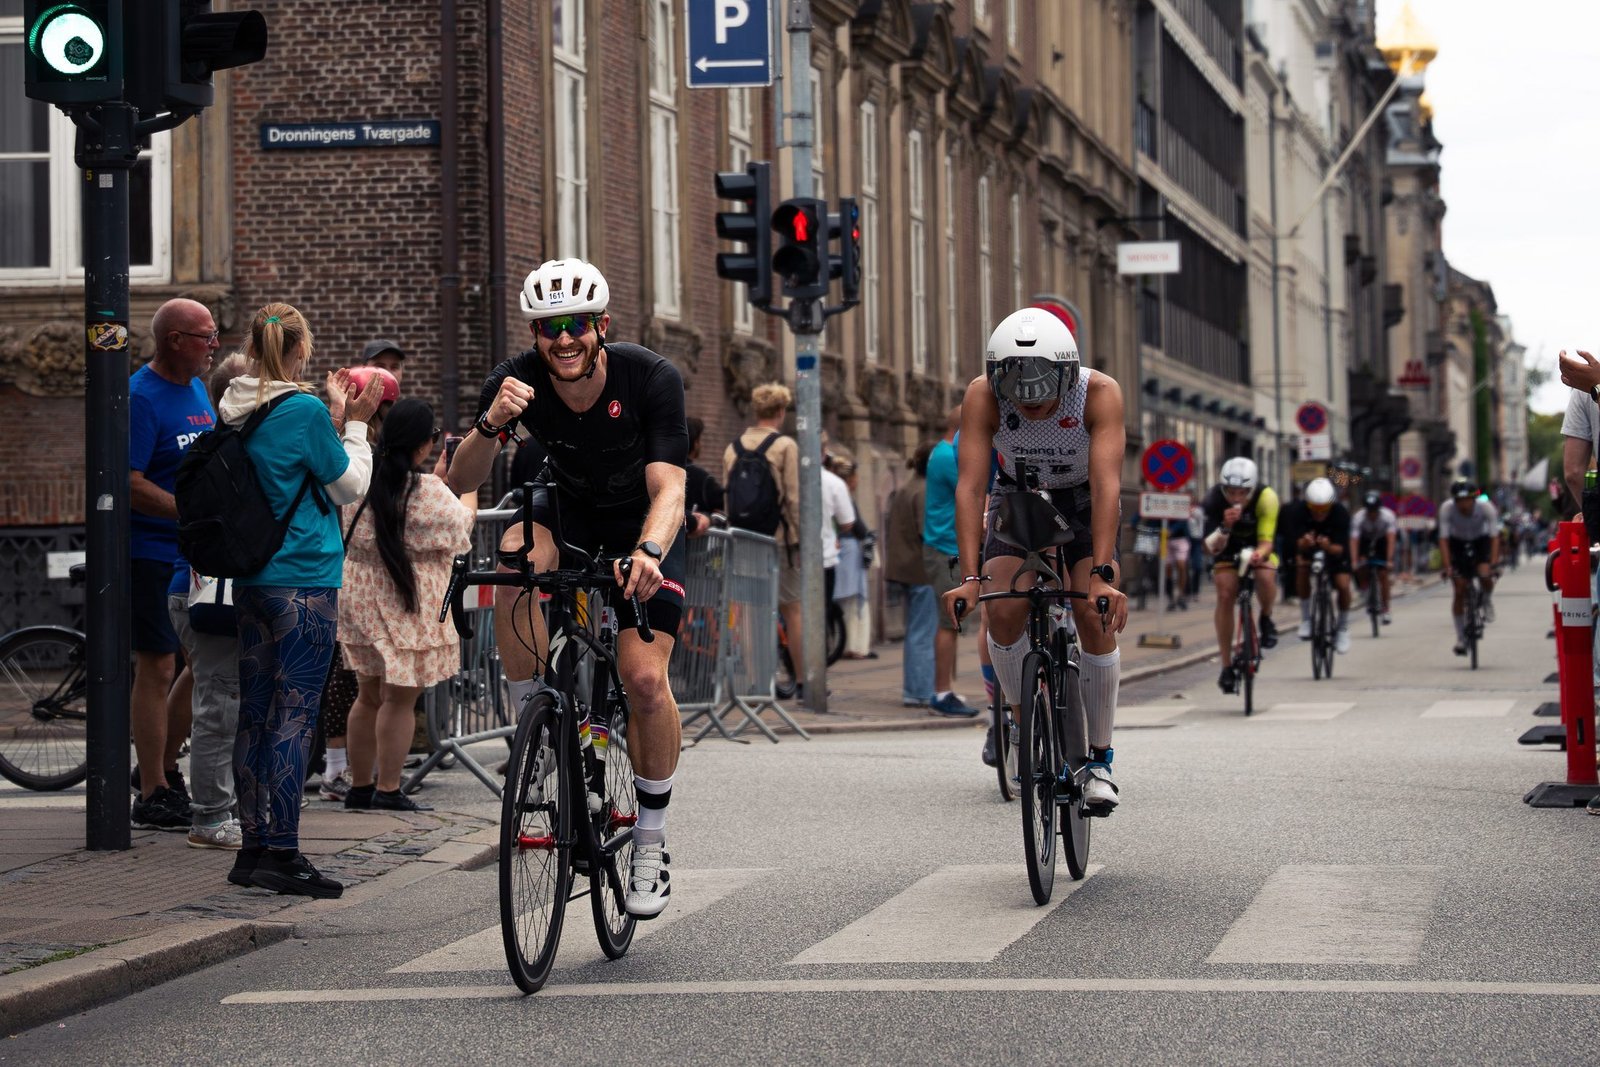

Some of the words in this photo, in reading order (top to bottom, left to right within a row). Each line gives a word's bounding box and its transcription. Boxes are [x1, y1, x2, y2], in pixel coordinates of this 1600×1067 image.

[715, 0, 750, 44] P
[269, 127, 356, 143] Dronningens
[362, 125, 432, 142] Tværgade
[549, 292, 565, 300] 1611
[1054, 351, 1070, 360] VAN
[1011, 446, 1055, 456] Zhang
[1059, 447, 1077, 455] Le
